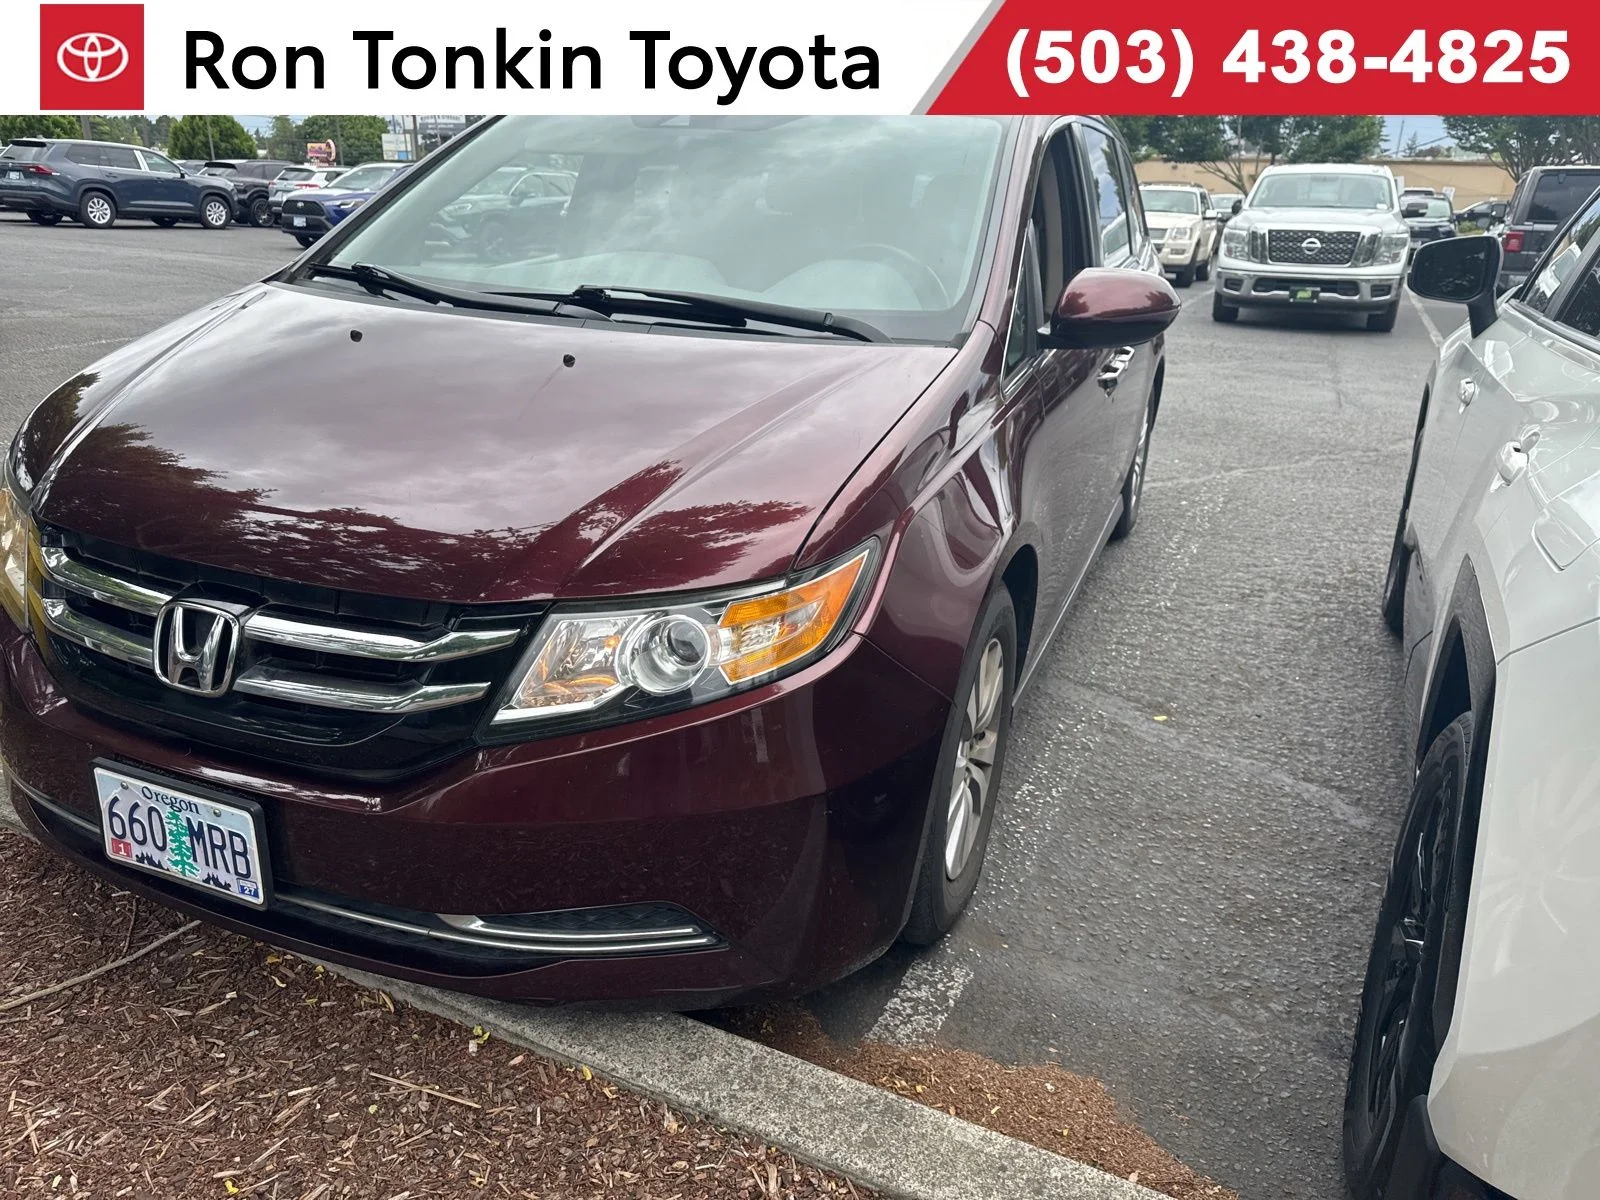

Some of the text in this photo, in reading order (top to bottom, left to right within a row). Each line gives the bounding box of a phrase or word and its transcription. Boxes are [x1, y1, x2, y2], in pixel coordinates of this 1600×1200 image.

[141, 786, 201, 815] Oregon
[108, 796, 251, 879] 660 MRB
[118, 843, 127, 856] 1
[243, 886, 255, 895] 27
